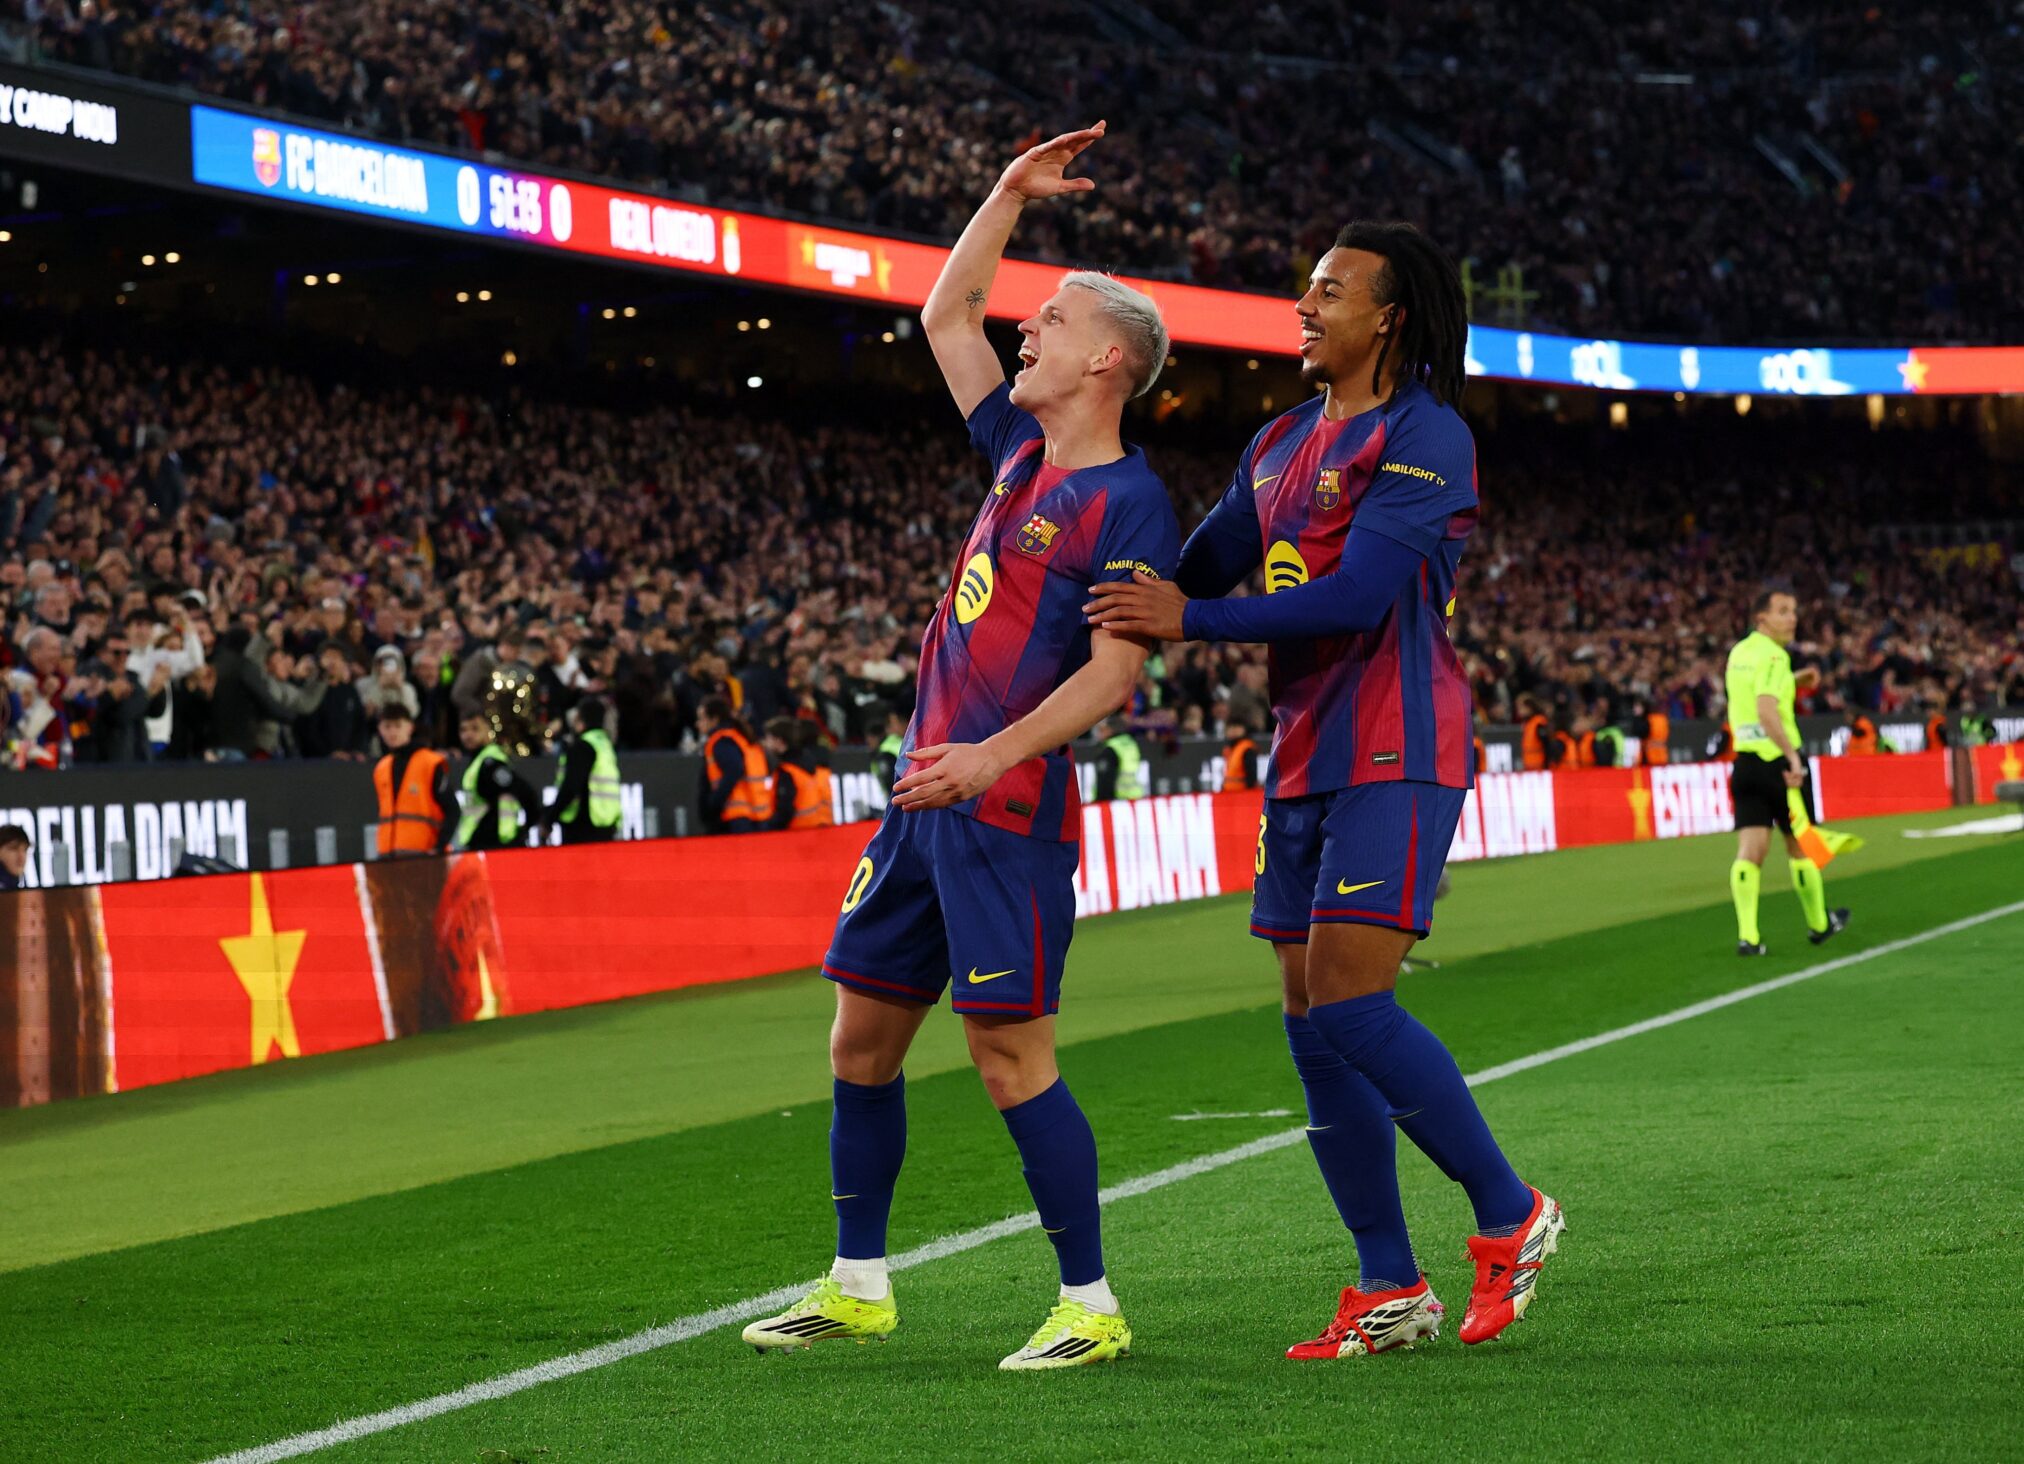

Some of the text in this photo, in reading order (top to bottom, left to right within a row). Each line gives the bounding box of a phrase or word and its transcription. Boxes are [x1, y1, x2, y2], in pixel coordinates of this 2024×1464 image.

[285, 133, 314, 192] FC
[457, 165, 480, 226] 0
[549, 184, 572, 242] 0
[133, 798, 250, 881] DAMM
